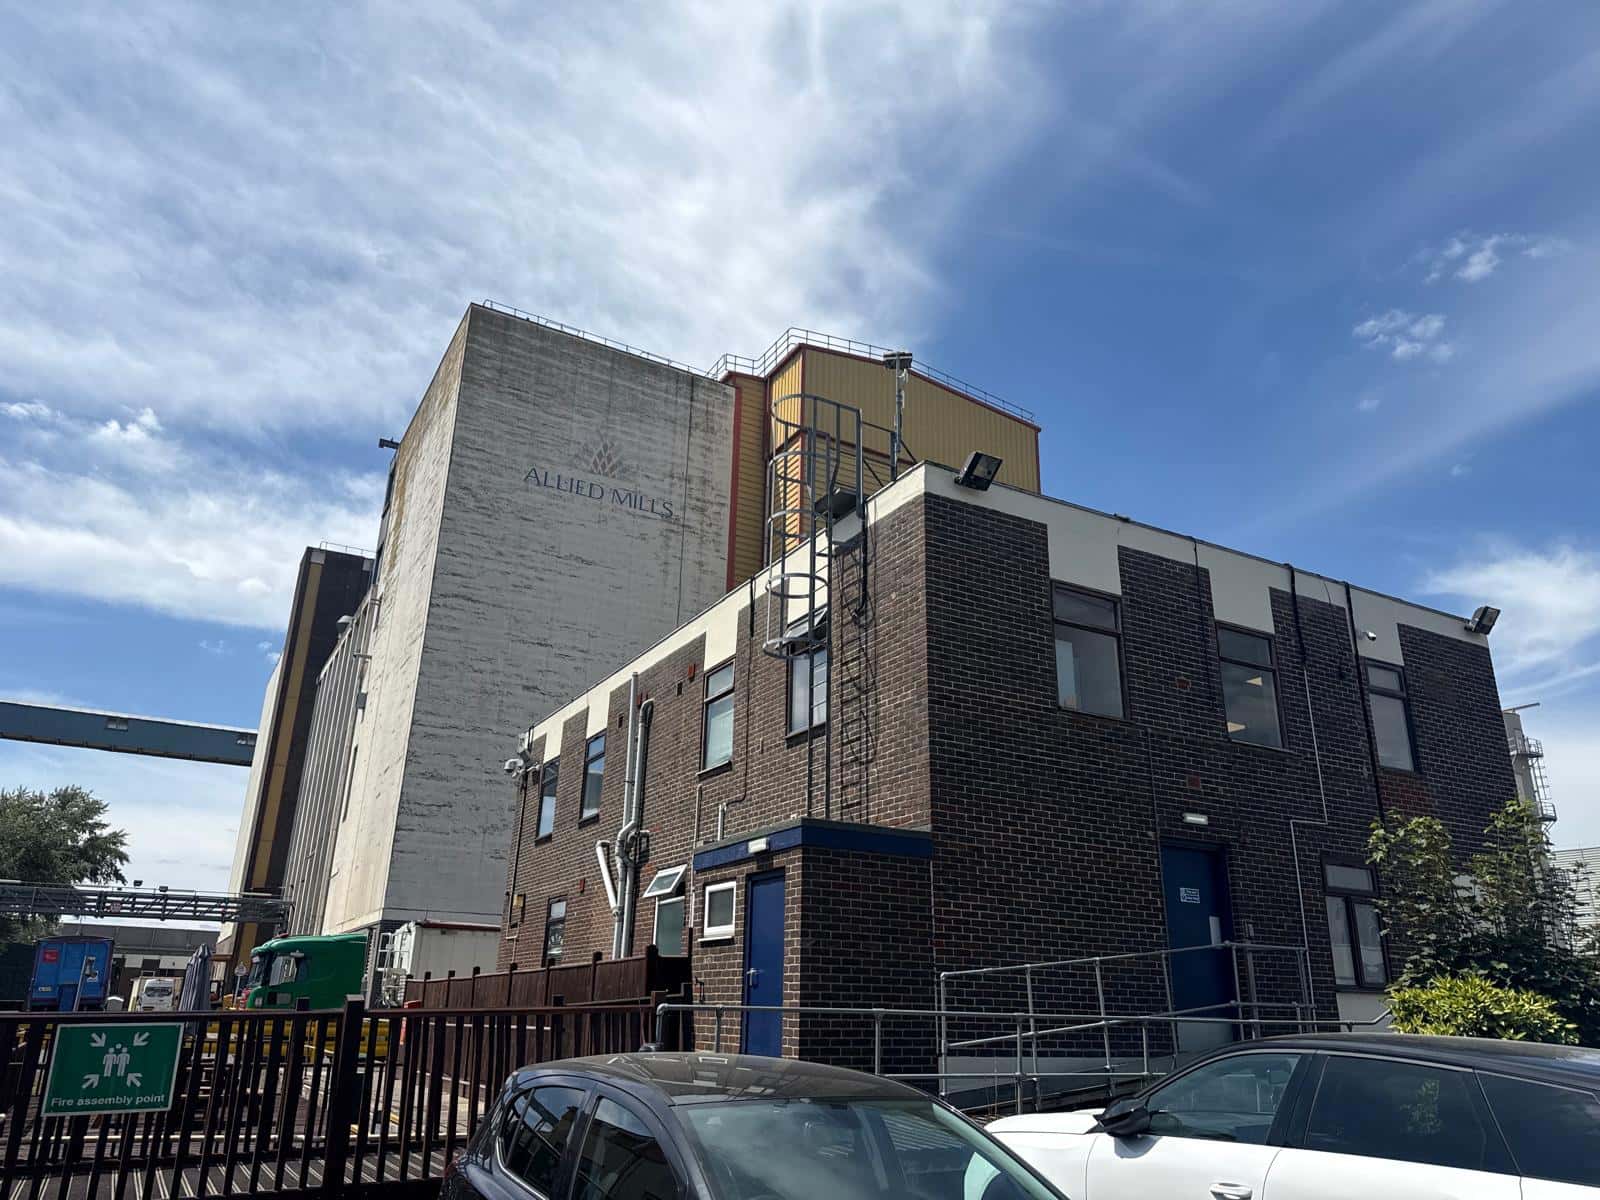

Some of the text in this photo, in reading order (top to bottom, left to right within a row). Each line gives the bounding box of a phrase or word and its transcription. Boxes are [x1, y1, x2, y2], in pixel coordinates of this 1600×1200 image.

[523, 467, 674, 518] ALLIED MILLS
[51, 1094, 165, 1107] Fire assembly point
